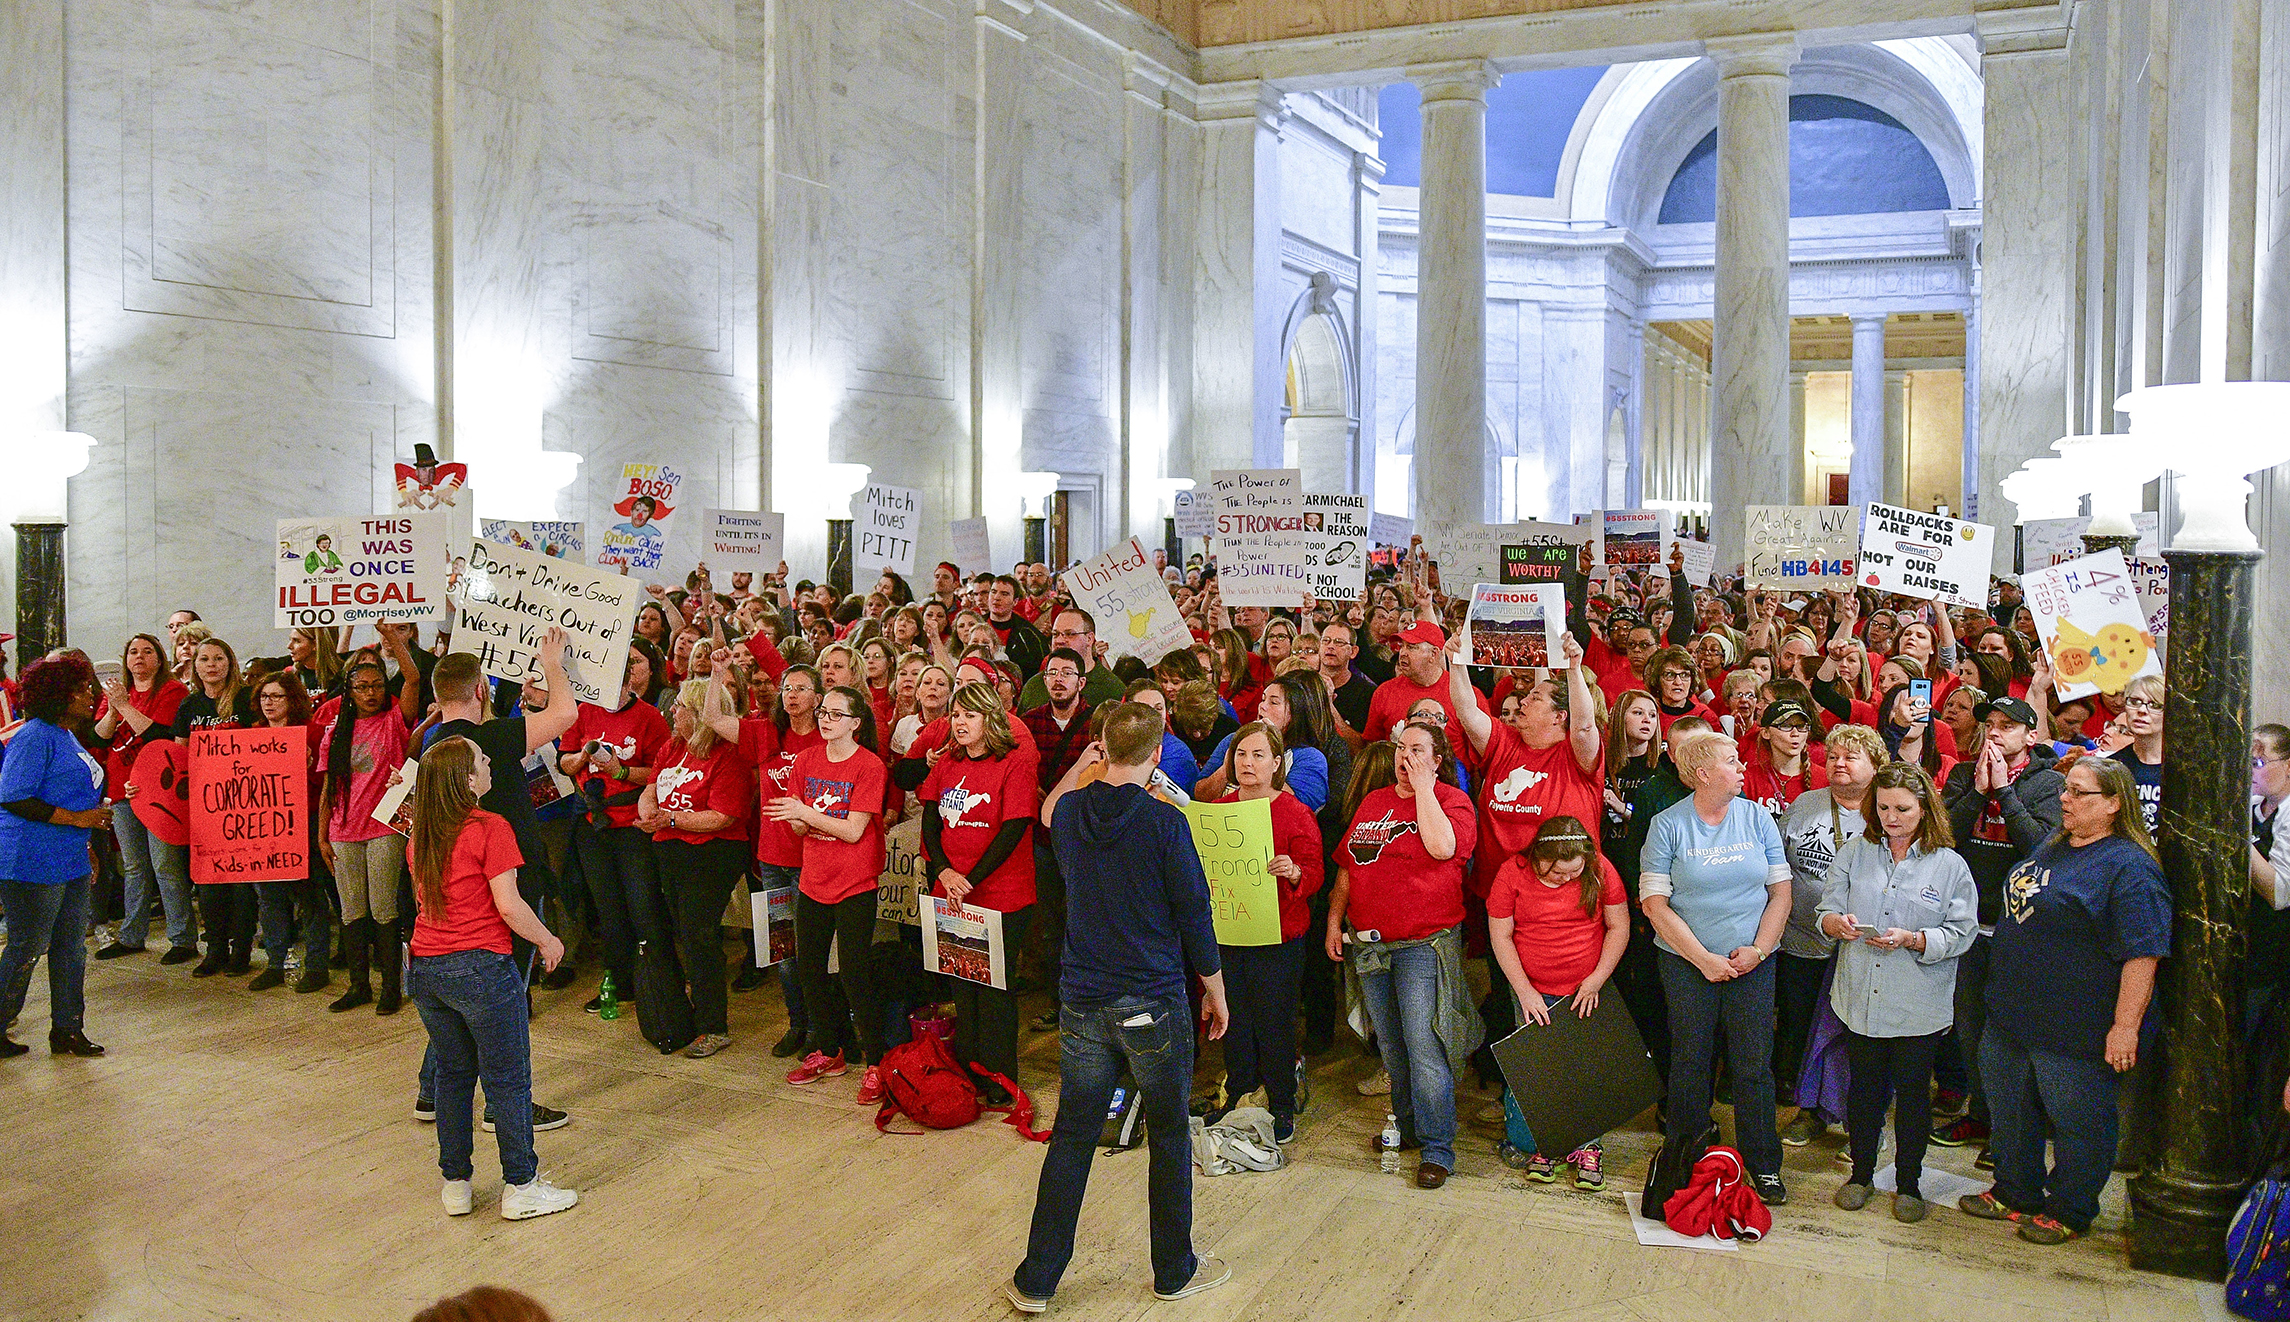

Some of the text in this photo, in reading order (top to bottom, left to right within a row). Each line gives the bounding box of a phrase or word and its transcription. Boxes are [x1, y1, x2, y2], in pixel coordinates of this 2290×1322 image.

[623, 463, 681, 486] HEY! Sen
[1213, 479, 1234, 492] THE
[1239, 473, 1275, 489] Power
[867, 487, 914, 512] Mitch
[1222, 495, 1243, 508] THE
[1246, 492, 1278, 508] People
[1301, 494, 1365, 509] ARMICHAEL
[361, 519, 412, 535] THIS
[532, 522, 579, 531] EXPECT
[873, 508, 905, 530] loves
[1217, 514, 1302, 534] STRONGER
[1334, 512, 1352, 524] THE
[1819, 509, 1850, 532] WV
[1870, 504, 1954, 532] ROLLBACKS
[482, 520, 508, 538] ELECT
[1327, 526, 1368, 537] REASON
[1754, 530, 1794, 545] Great
[1878, 520, 1953, 547] ARE FOR
[362, 539, 413, 555] WAS
[549, 531, 582, 551] CIRCUS
[603, 545, 622, 556] They
[861, 531, 911, 561] PITT
[1264, 535, 1293, 548] People
[1897, 542, 1930, 556] Walmart
[631, 556, 661, 570] BACK!
[1236, 549, 1269, 561] Power
[1752, 552, 1778, 577] Fund
[1862, 550, 1937, 574] NOT OUR
[350, 559, 415, 576] ONCE
[469, 543, 623, 607] Don't Drive Good
[1074, 540, 1147, 592] United
[1508, 562, 1561, 580] WORTHY
[1317, 574, 1338, 586] NOT
[1903, 573, 1959, 595] RAISES
[279, 582, 426, 608] ILLEGAL
[1314, 586, 1357, 599] SCHOOL
[1946, 594, 1957, 602] 55
[2032, 582, 2053, 616] FEED
[2044, 568, 2073, 619] CHICKEN
[286, 606, 435, 626] TOO @MorriseyWV
[560, 608, 598, 635] Out
[600, 618, 622, 641] of
[461, 608, 609, 669] West Virnia!
[562, 665, 601, 701] rong
[197, 734, 288, 757] Mitch works
[232, 760, 253, 776] for
[203, 773, 295, 813] CORPORATE
[668, 791, 693, 809] 55
[1488, 799, 1543, 816] Fayette County
[223, 810, 294, 840] GREED!
[1200, 814, 1245, 849] 55
[1686, 841, 1755, 857] KINDERGARTEN
[1702, 853, 1746, 867] Team
[1210, 879, 1235, 899] Fix
